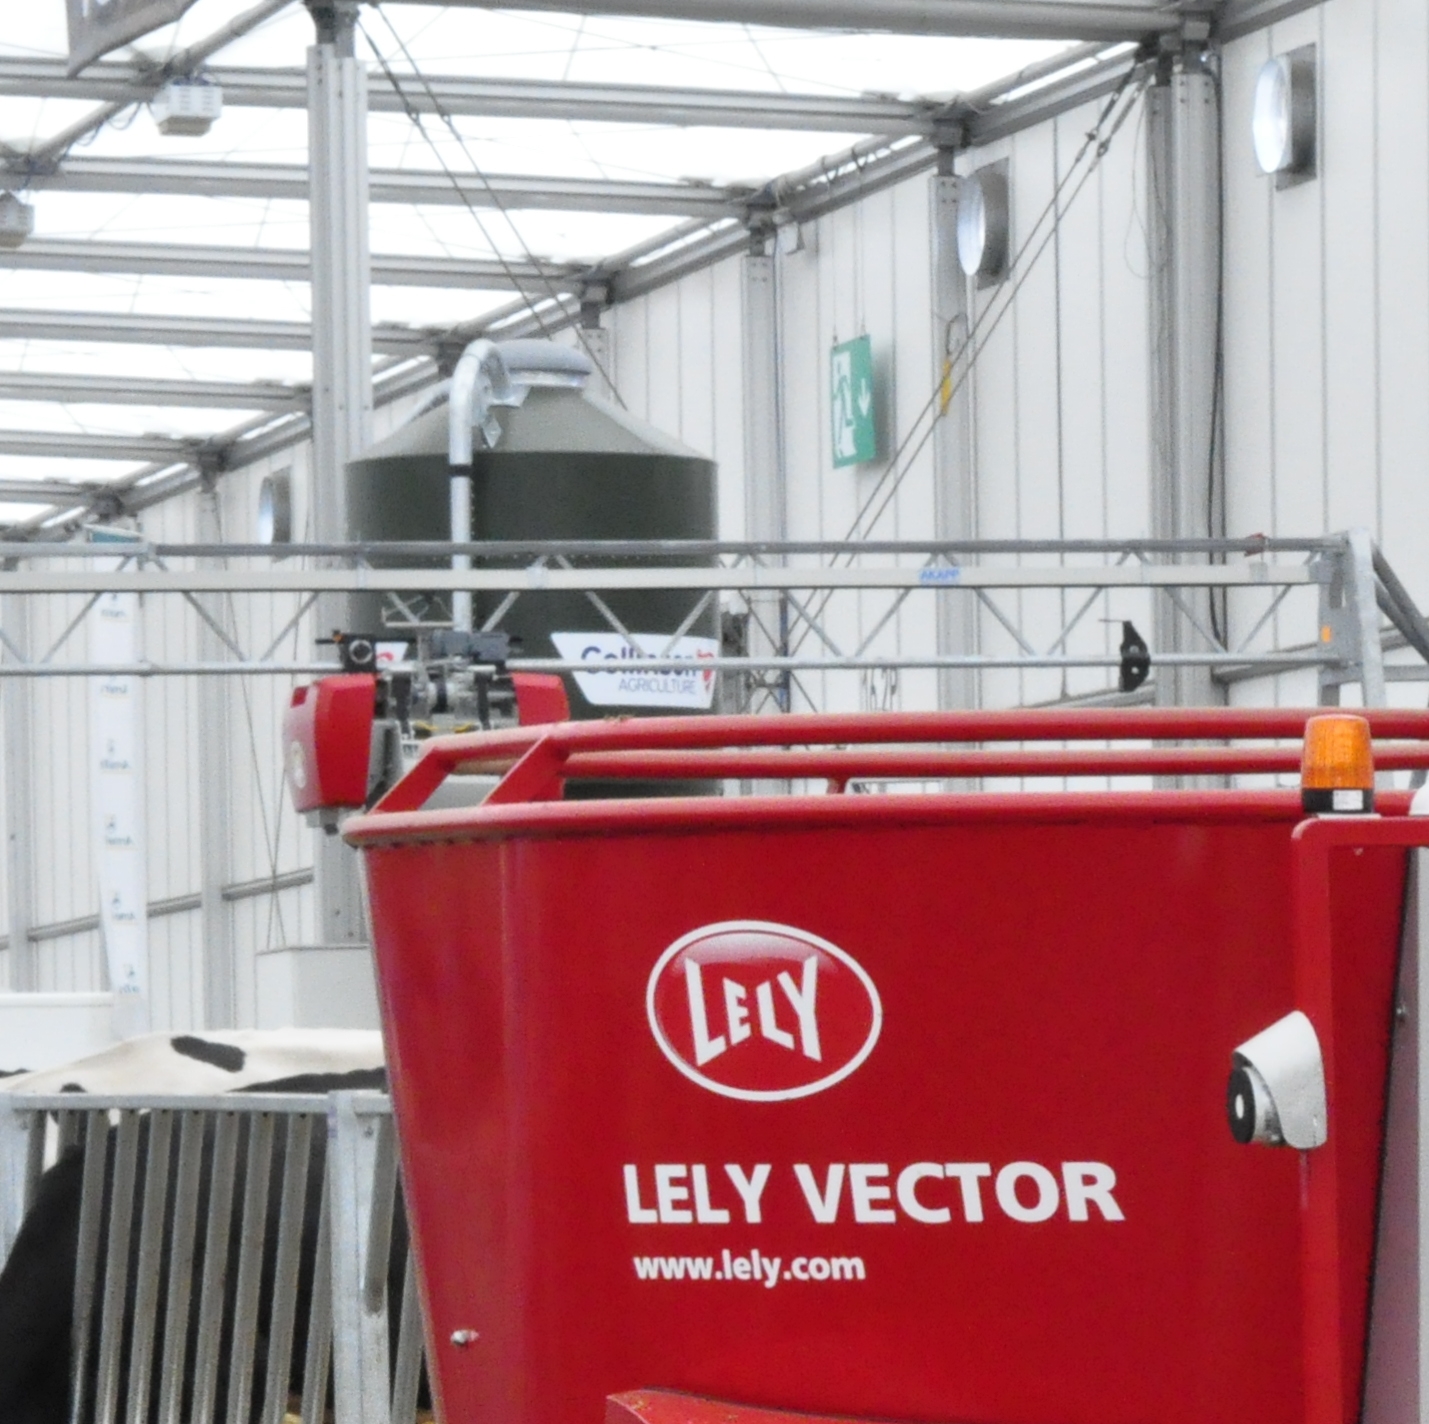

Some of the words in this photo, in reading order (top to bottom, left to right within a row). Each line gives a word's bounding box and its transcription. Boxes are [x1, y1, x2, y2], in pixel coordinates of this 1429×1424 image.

[618, 677, 697, 695] AGRICULTURE
[685, 955, 822, 1067] LELY
[623, 1163, 772, 1224] LELY
[793, 1161, 1126, 1224] VECTOR
[633, 1248, 866, 1289] www.lely.com
